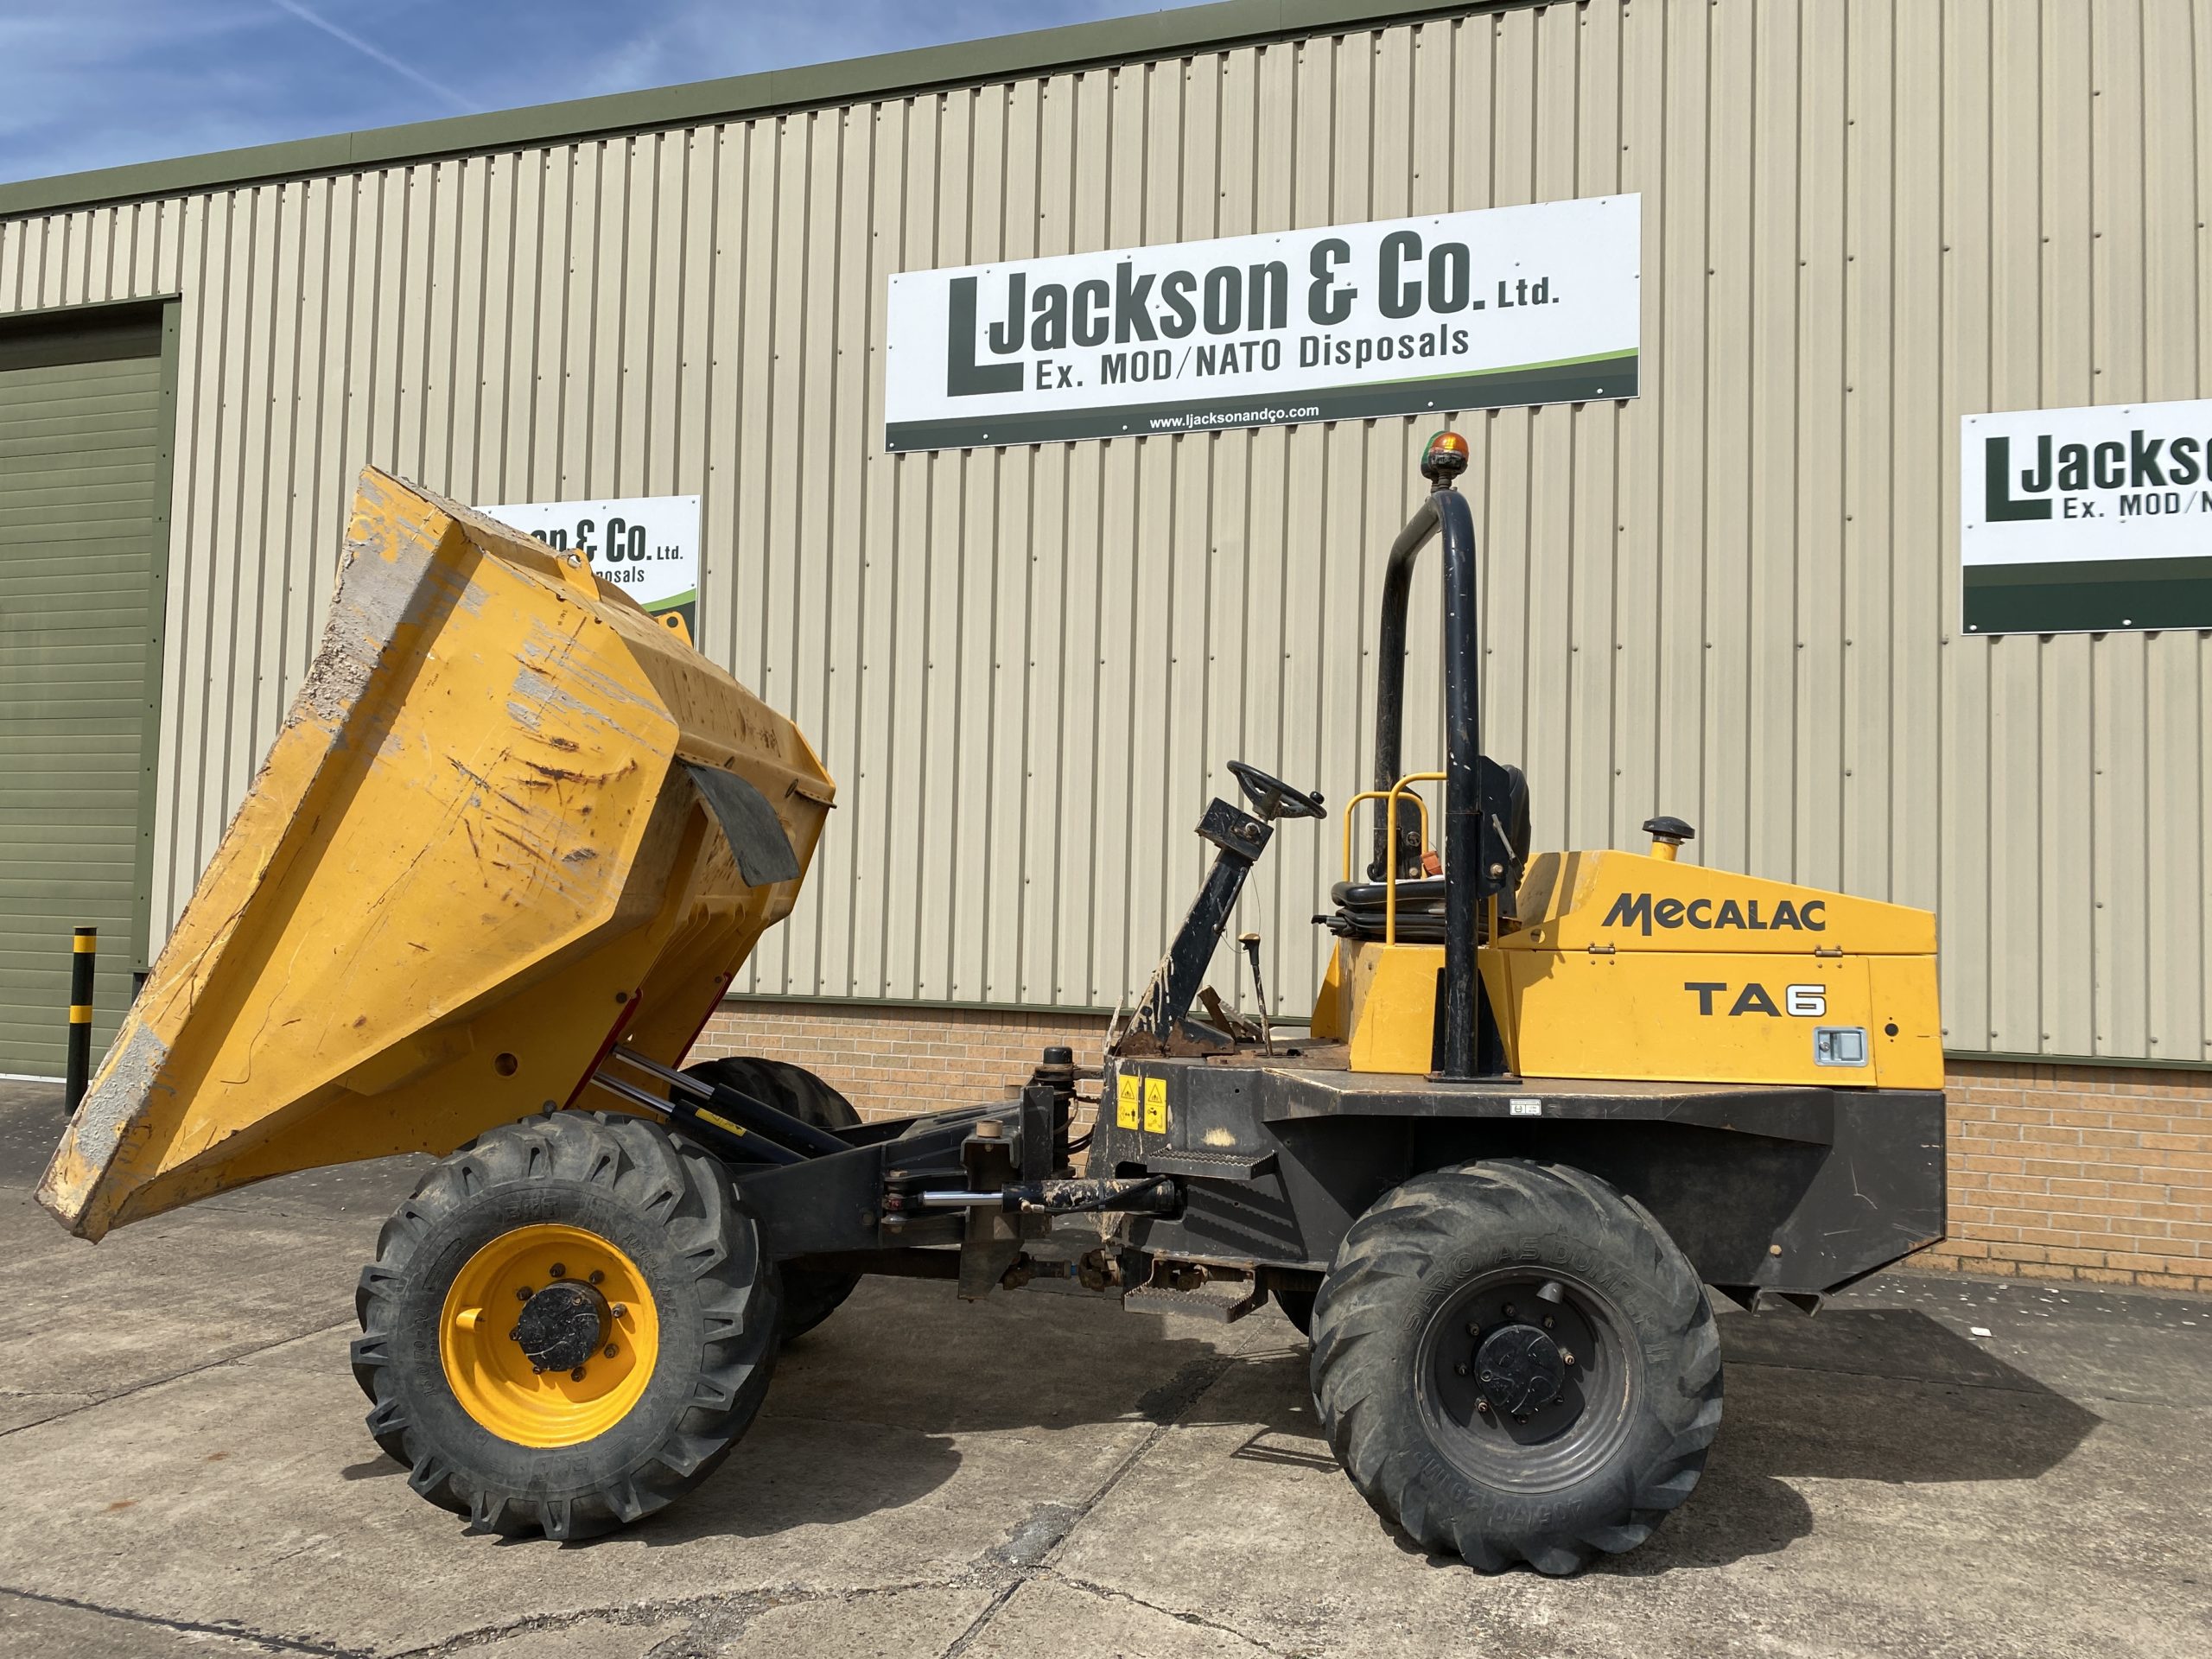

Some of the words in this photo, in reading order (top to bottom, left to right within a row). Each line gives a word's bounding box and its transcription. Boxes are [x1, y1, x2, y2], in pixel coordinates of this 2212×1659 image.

[1307, 238, 1357, 326] &
[1378, 230, 1485, 319] Co.
[1497, 276, 1560, 308] Ltd.
[1036, 359, 1083, 390] Ex.
[1101, 338, 1281, 385] MOD/NATO
[1300, 323, 1469, 369] Disposals
[1149, 406, 1319, 429] www.ljacksonandco.com
[1986, 429, 2212, 523] LJacks
[2063, 498, 2104, 518] Ex.
[606, 517, 652, 563] Co.
[657, 545, 683, 561] Ltd.
[1684, 982, 1827, 1017] TA6
